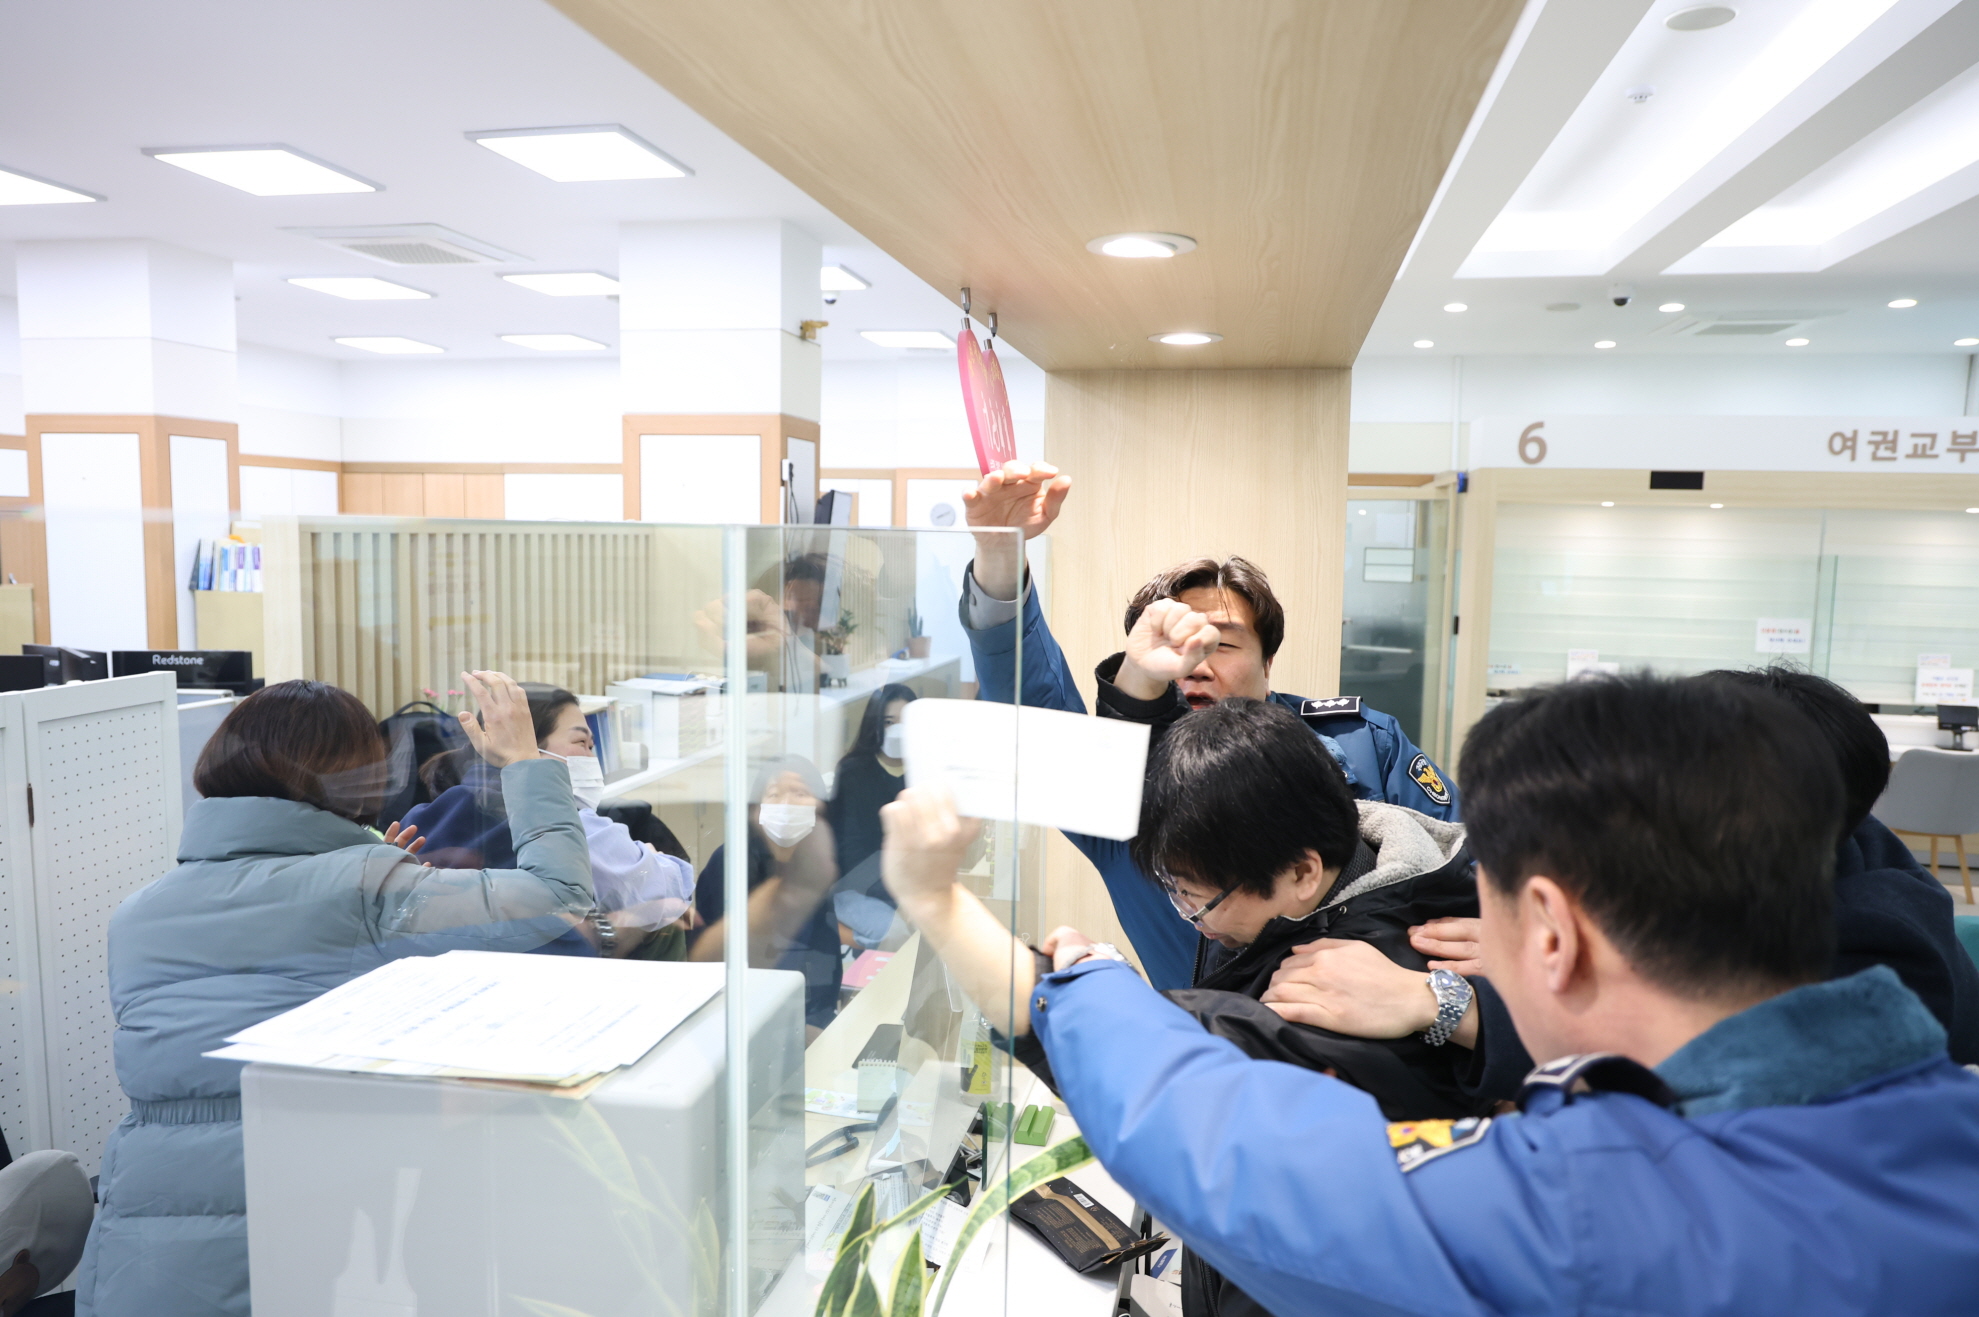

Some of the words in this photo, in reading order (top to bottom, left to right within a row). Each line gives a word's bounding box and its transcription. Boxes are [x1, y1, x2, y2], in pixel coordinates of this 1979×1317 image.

[1518, 421, 1547, 465] 6
[1828, 429, 1979, 463] 여권교부
[152, 654, 204, 665] Redstone
